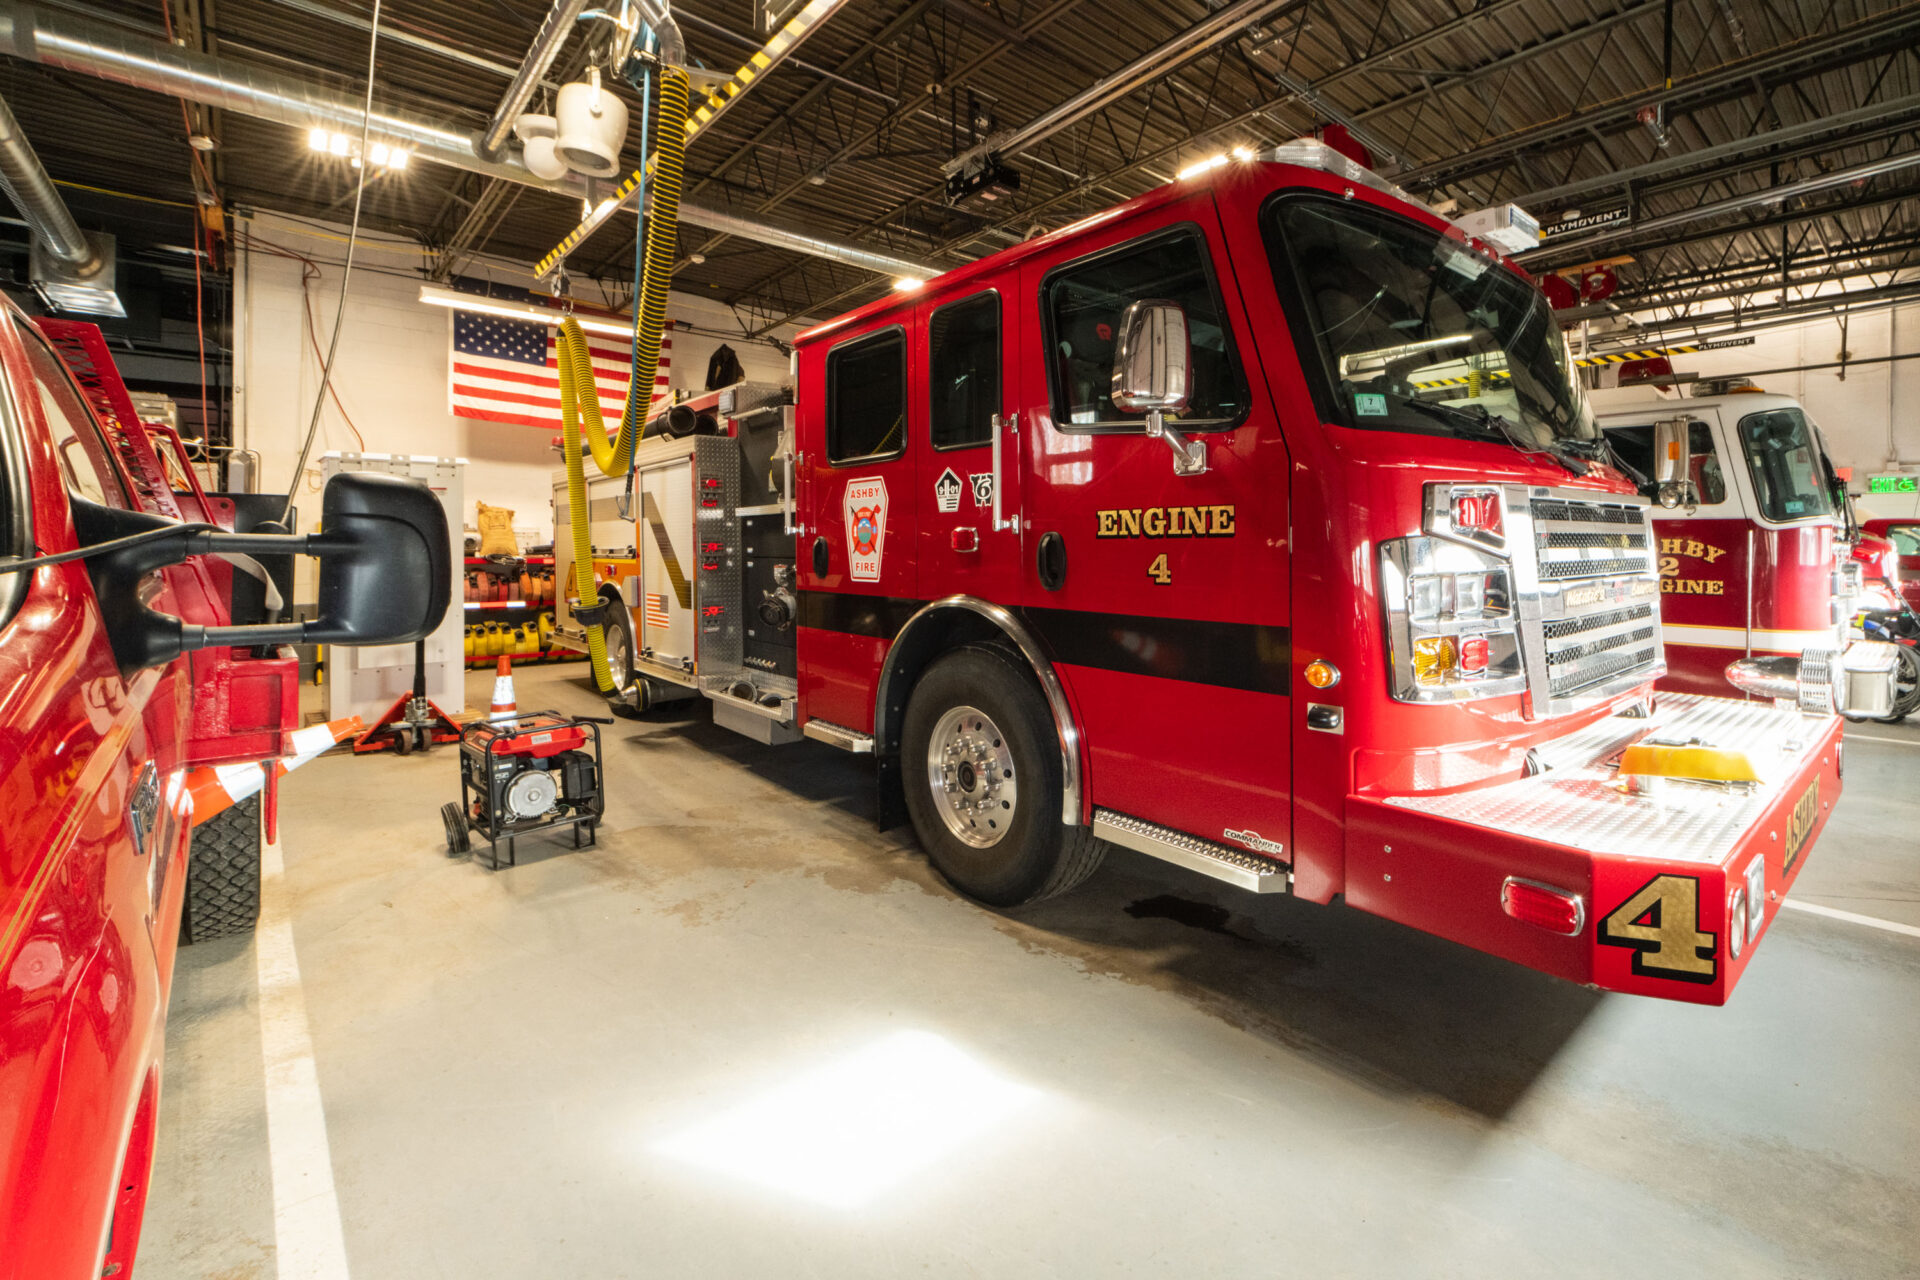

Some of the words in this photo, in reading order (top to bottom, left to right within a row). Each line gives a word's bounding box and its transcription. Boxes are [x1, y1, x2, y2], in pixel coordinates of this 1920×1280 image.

[1547, 209, 1622, 235] PLYMOVENT
[1699, 338, 1751, 350] PLYMOVENT
[850, 487, 879, 499] ASHBY
[1872, 477, 1896, 492] EXIT
[1097, 504, 1236, 539] ENGINE
[1660, 538, 1727, 564] HBY
[855, 562, 875, 572] FIRE
[1148, 553, 1171, 585] 4
[1659, 556, 1680, 577] 2
[1660, 578, 1724, 595] GINE
[1783, 771, 1820, 876] ASHBY
[1225, 830, 1281, 851] COMMANDER
[1597, 873, 1717, 985] 4
